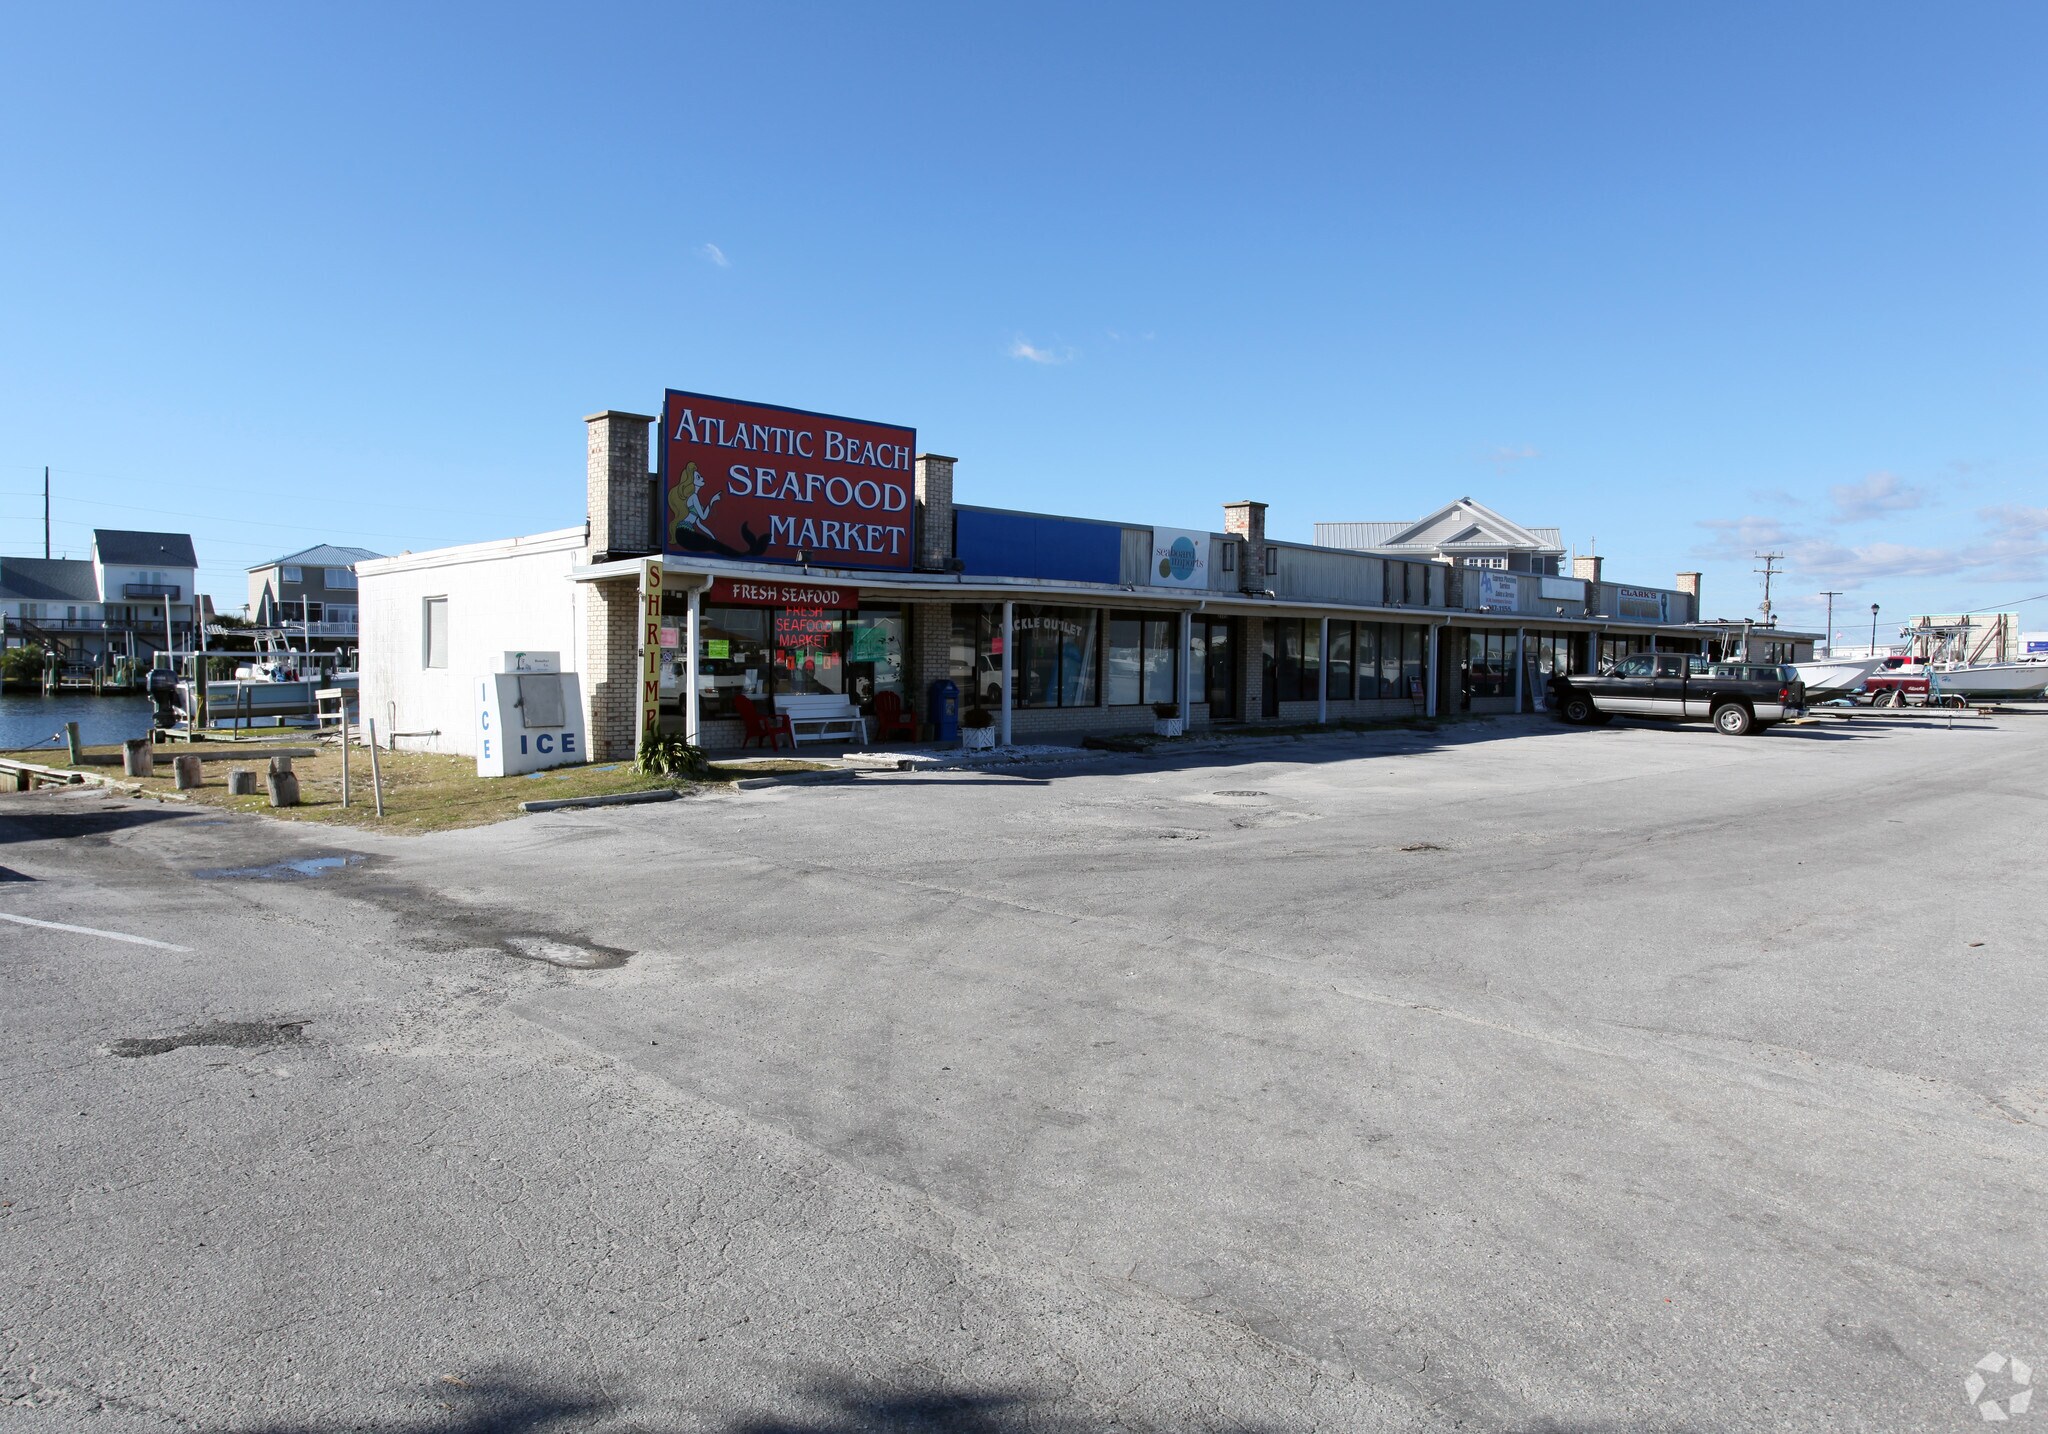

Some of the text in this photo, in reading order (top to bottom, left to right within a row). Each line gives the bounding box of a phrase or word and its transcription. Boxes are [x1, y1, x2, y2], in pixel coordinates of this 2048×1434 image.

[674, 408, 910, 471] ATLANTIC BEACH
[728, 464, 907, 512] SEAFOOD
[769, 515, 905, 554] MARKET
[1156, 545, 1195, 558] seaboard
[733, 584, 840, 604] FRESH SEAFOOD
[1620, 588, 1657, 599] CLARK'S
[786, 605, 822, 617] FRESH
[776, 618, 833, 632] SEAFOOD
[644, 565, 661, 732] SHRIMP
[779, 633, 829, 648] MARKET
[481, 682, 491, 759] ICE
[520, 733, 576, 755] ICE
